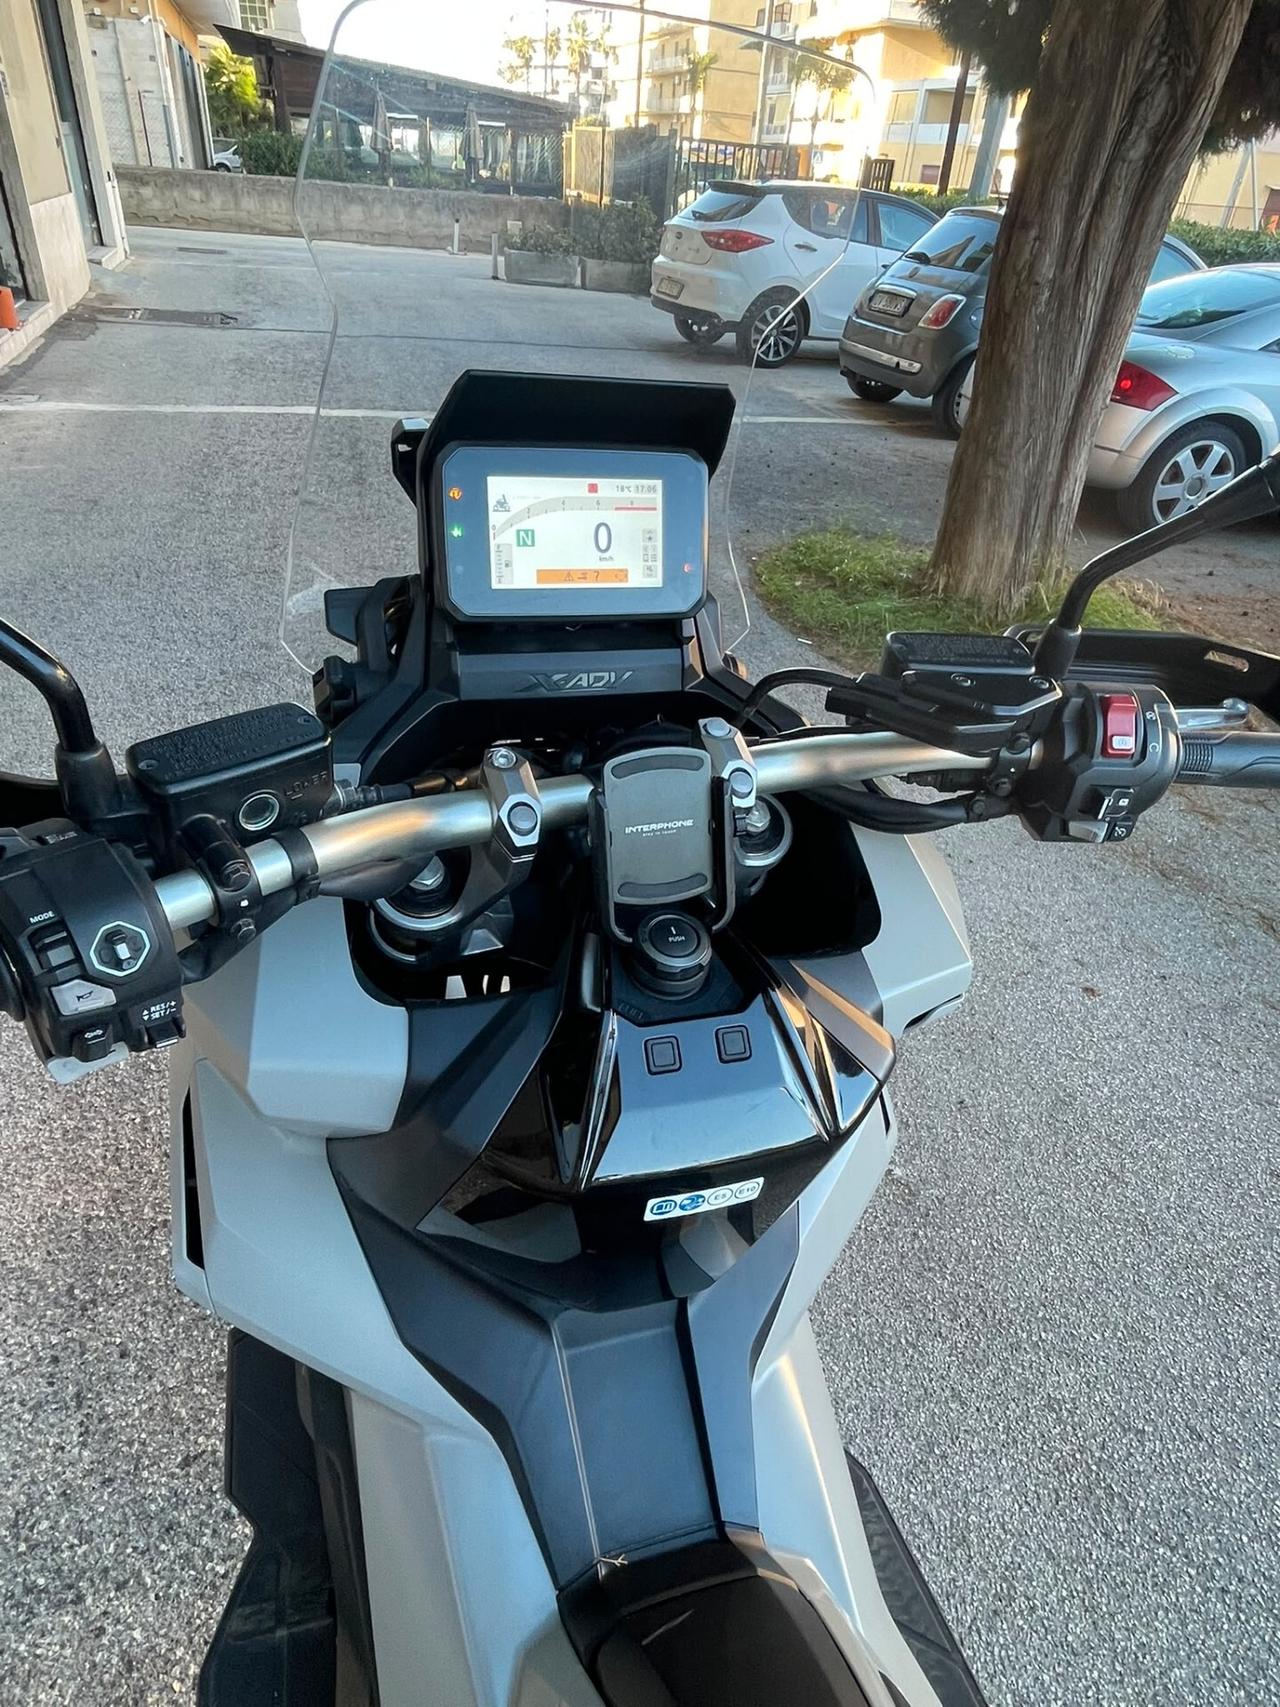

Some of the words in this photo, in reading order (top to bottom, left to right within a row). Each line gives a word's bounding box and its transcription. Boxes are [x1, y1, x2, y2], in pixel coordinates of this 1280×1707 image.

[519, 532, 533, 545] N
[593, 522, 612, 554] 0
[625, 819, 694, 834] INTERPHONE
[29, 911, 55, 923] MODE
[668, 935, 686, 943] PUSH
